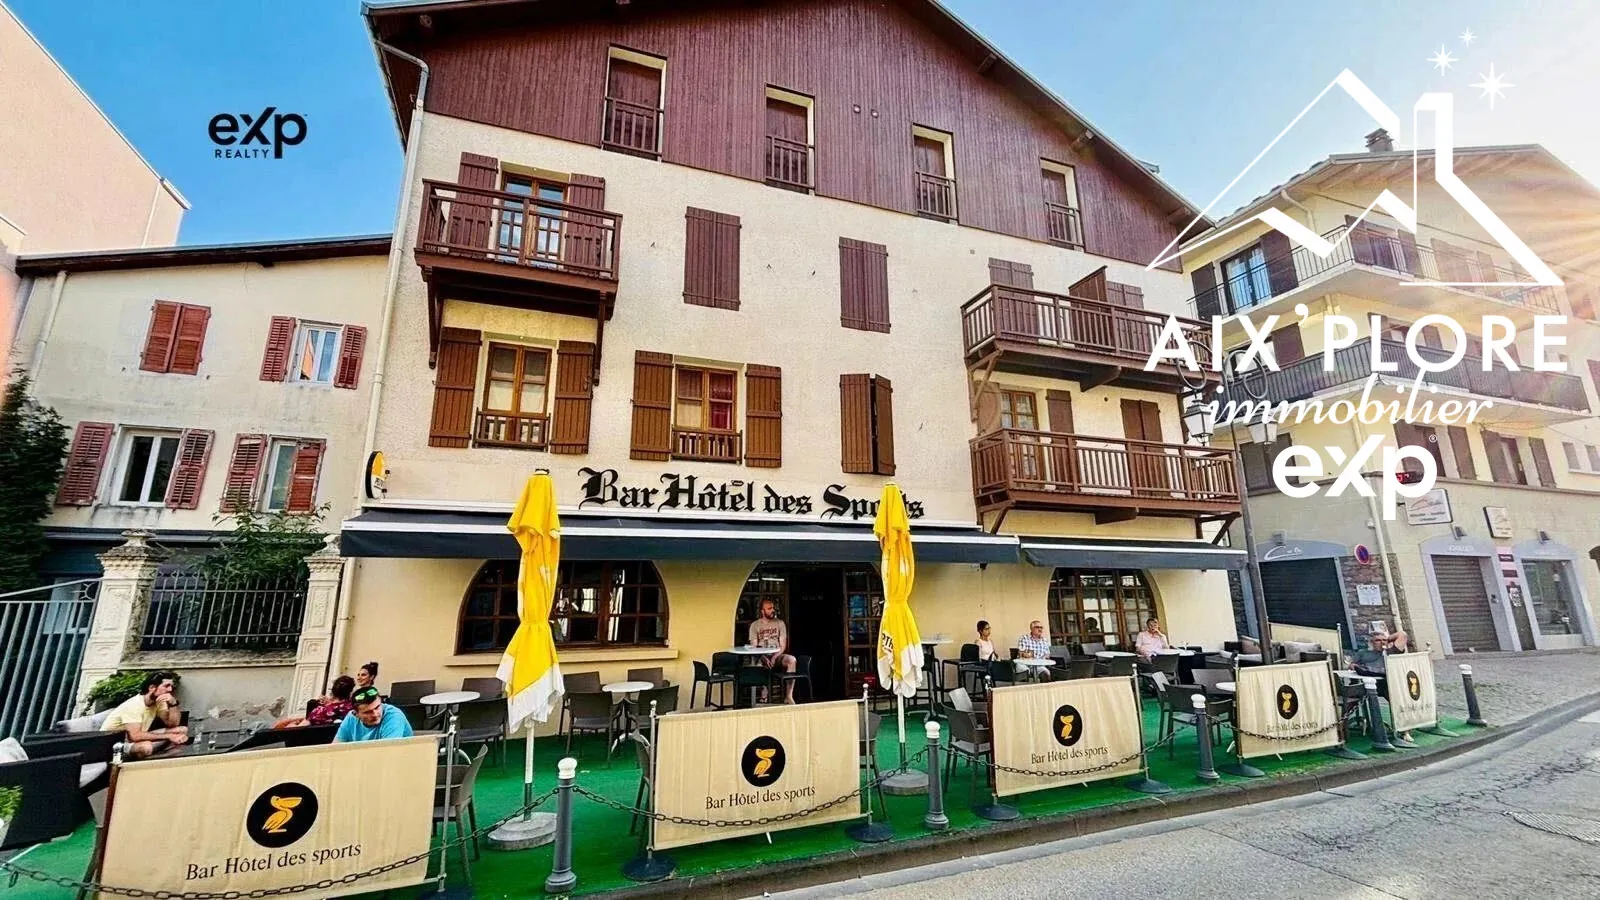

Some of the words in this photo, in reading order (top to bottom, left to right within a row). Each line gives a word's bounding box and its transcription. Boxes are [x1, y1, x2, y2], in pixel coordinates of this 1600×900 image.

[578, 467, 659, 510] Bar
[657, 473, 756, 512] Hôtel
[763, 483, 813, 514] des
[1031, 753, 1046, 765] Bar
[1070, 747, 1083, 759] des
[1084, 745, 1109, 759] sports
[705, 796, 726, 810] Bar
[729, 791, 760, 807] Hôtel
[762, 789, 781, 802] des
[784, 785, 816, 803] sports
[185, 863, 219, 881] Bar
[224, 853, 272, 875] Hôtel
[277, 851, 307, 868] des
[311, 843, 362, 865] sports
